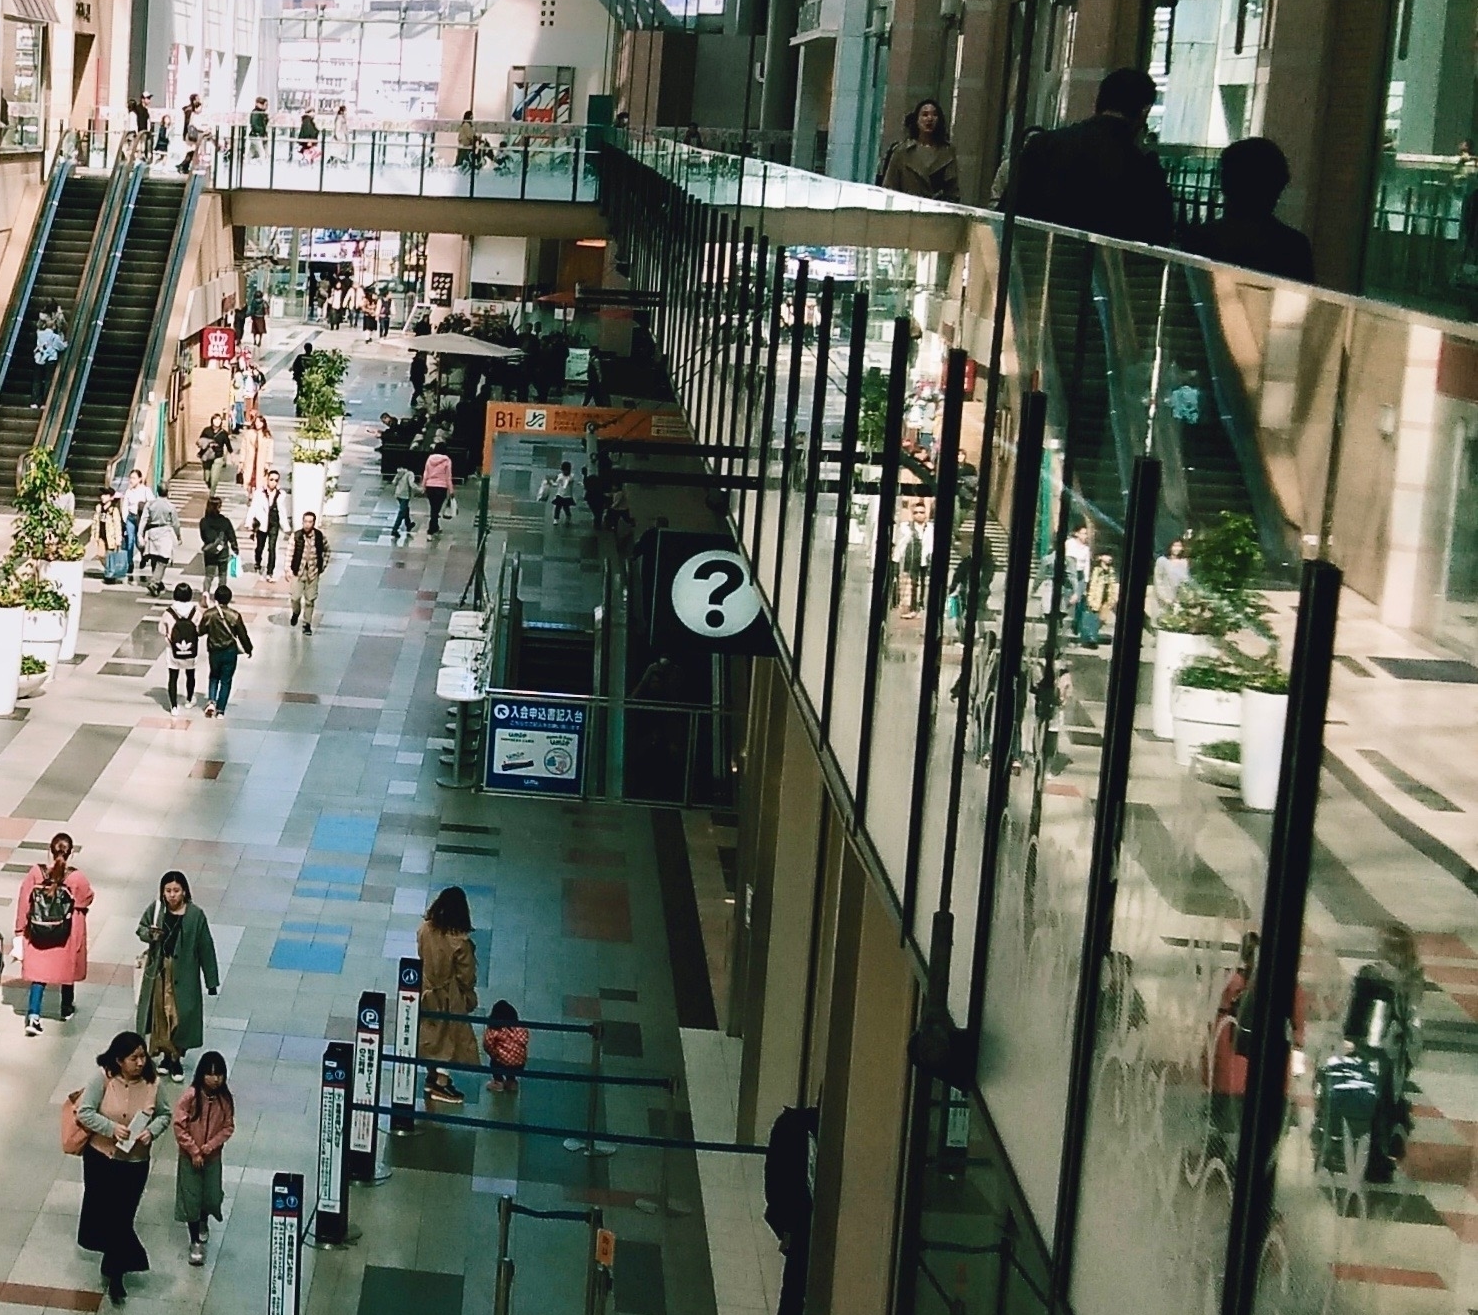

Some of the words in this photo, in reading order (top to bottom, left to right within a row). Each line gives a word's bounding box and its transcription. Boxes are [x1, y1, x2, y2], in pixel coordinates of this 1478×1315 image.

[510, 705, 583, 723] 入会申込書記入台
